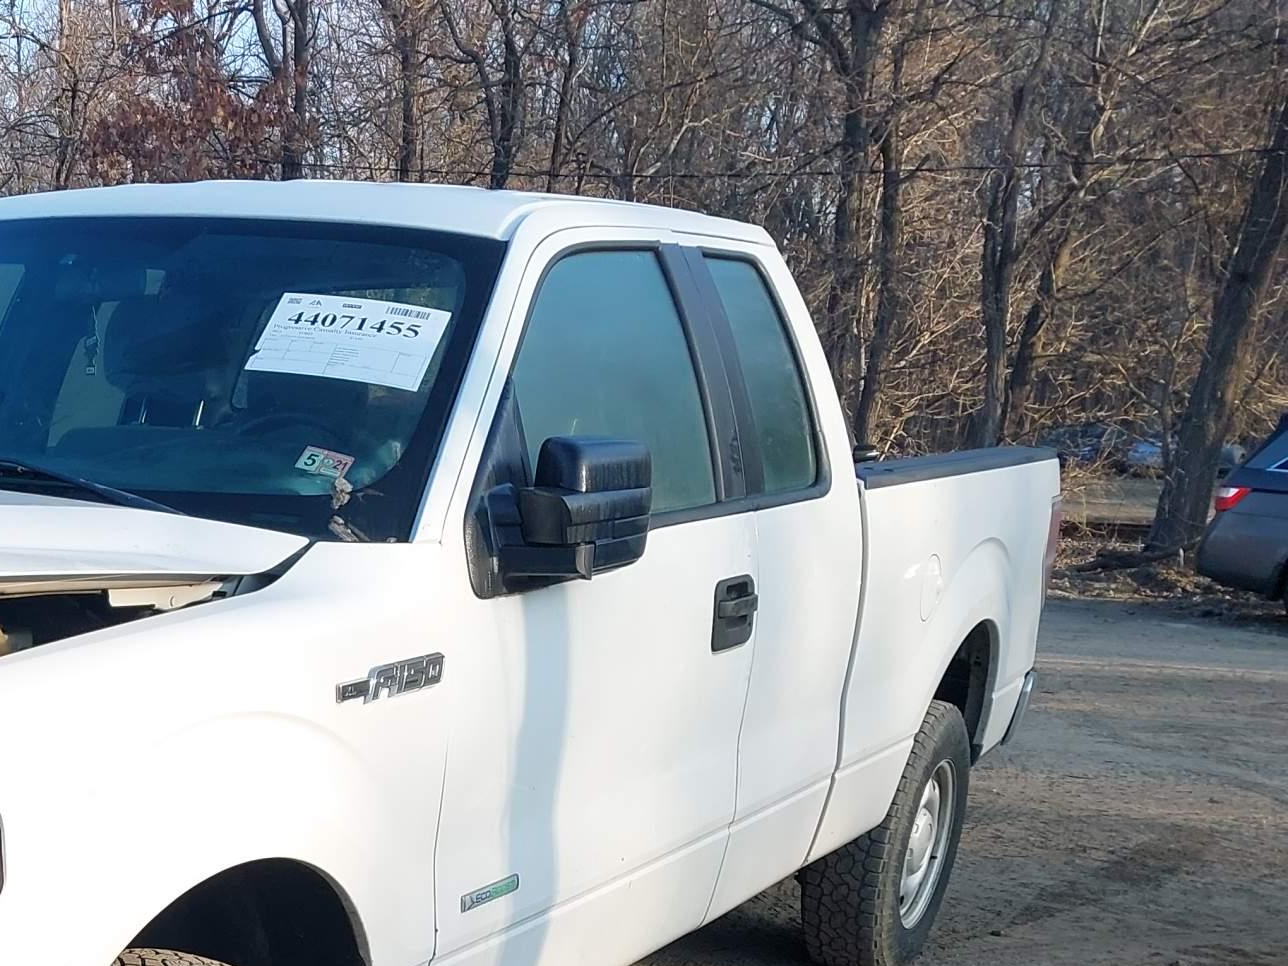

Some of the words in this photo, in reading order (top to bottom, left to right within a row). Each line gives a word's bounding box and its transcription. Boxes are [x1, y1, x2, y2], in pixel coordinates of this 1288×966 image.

[287, 310, 423, 339] 44071455
[344, 328, 377, 338] Insurance
[303, 453, 320, 467] 5
[332, 459, 349, 471] 21
